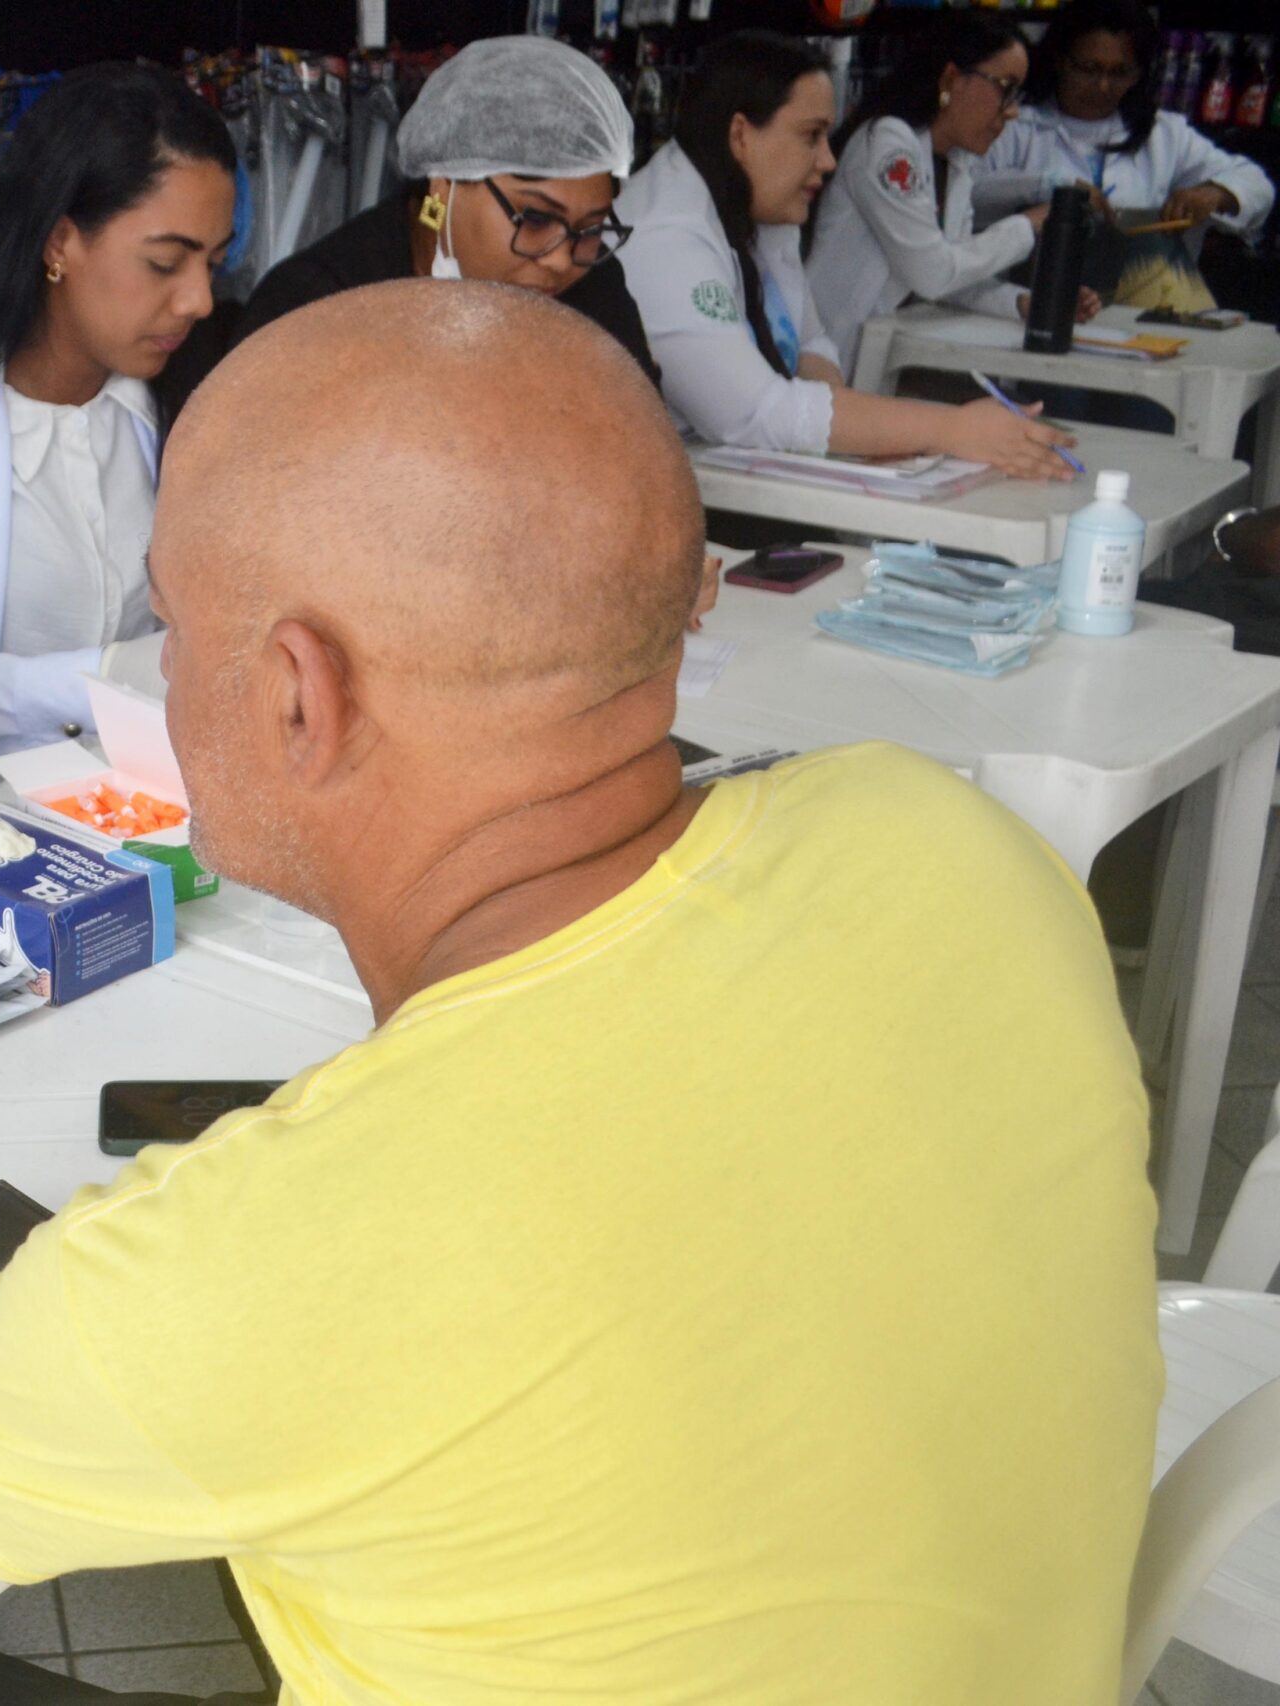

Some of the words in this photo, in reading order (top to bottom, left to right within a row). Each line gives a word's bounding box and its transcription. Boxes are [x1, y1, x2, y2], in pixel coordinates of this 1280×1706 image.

[36, 848, 117, 885] Procedimento
[50, 844, 104, 872] Cirúrgico
[46, 863, 78, 880] para
[74, 878, 105, 891] Luva
